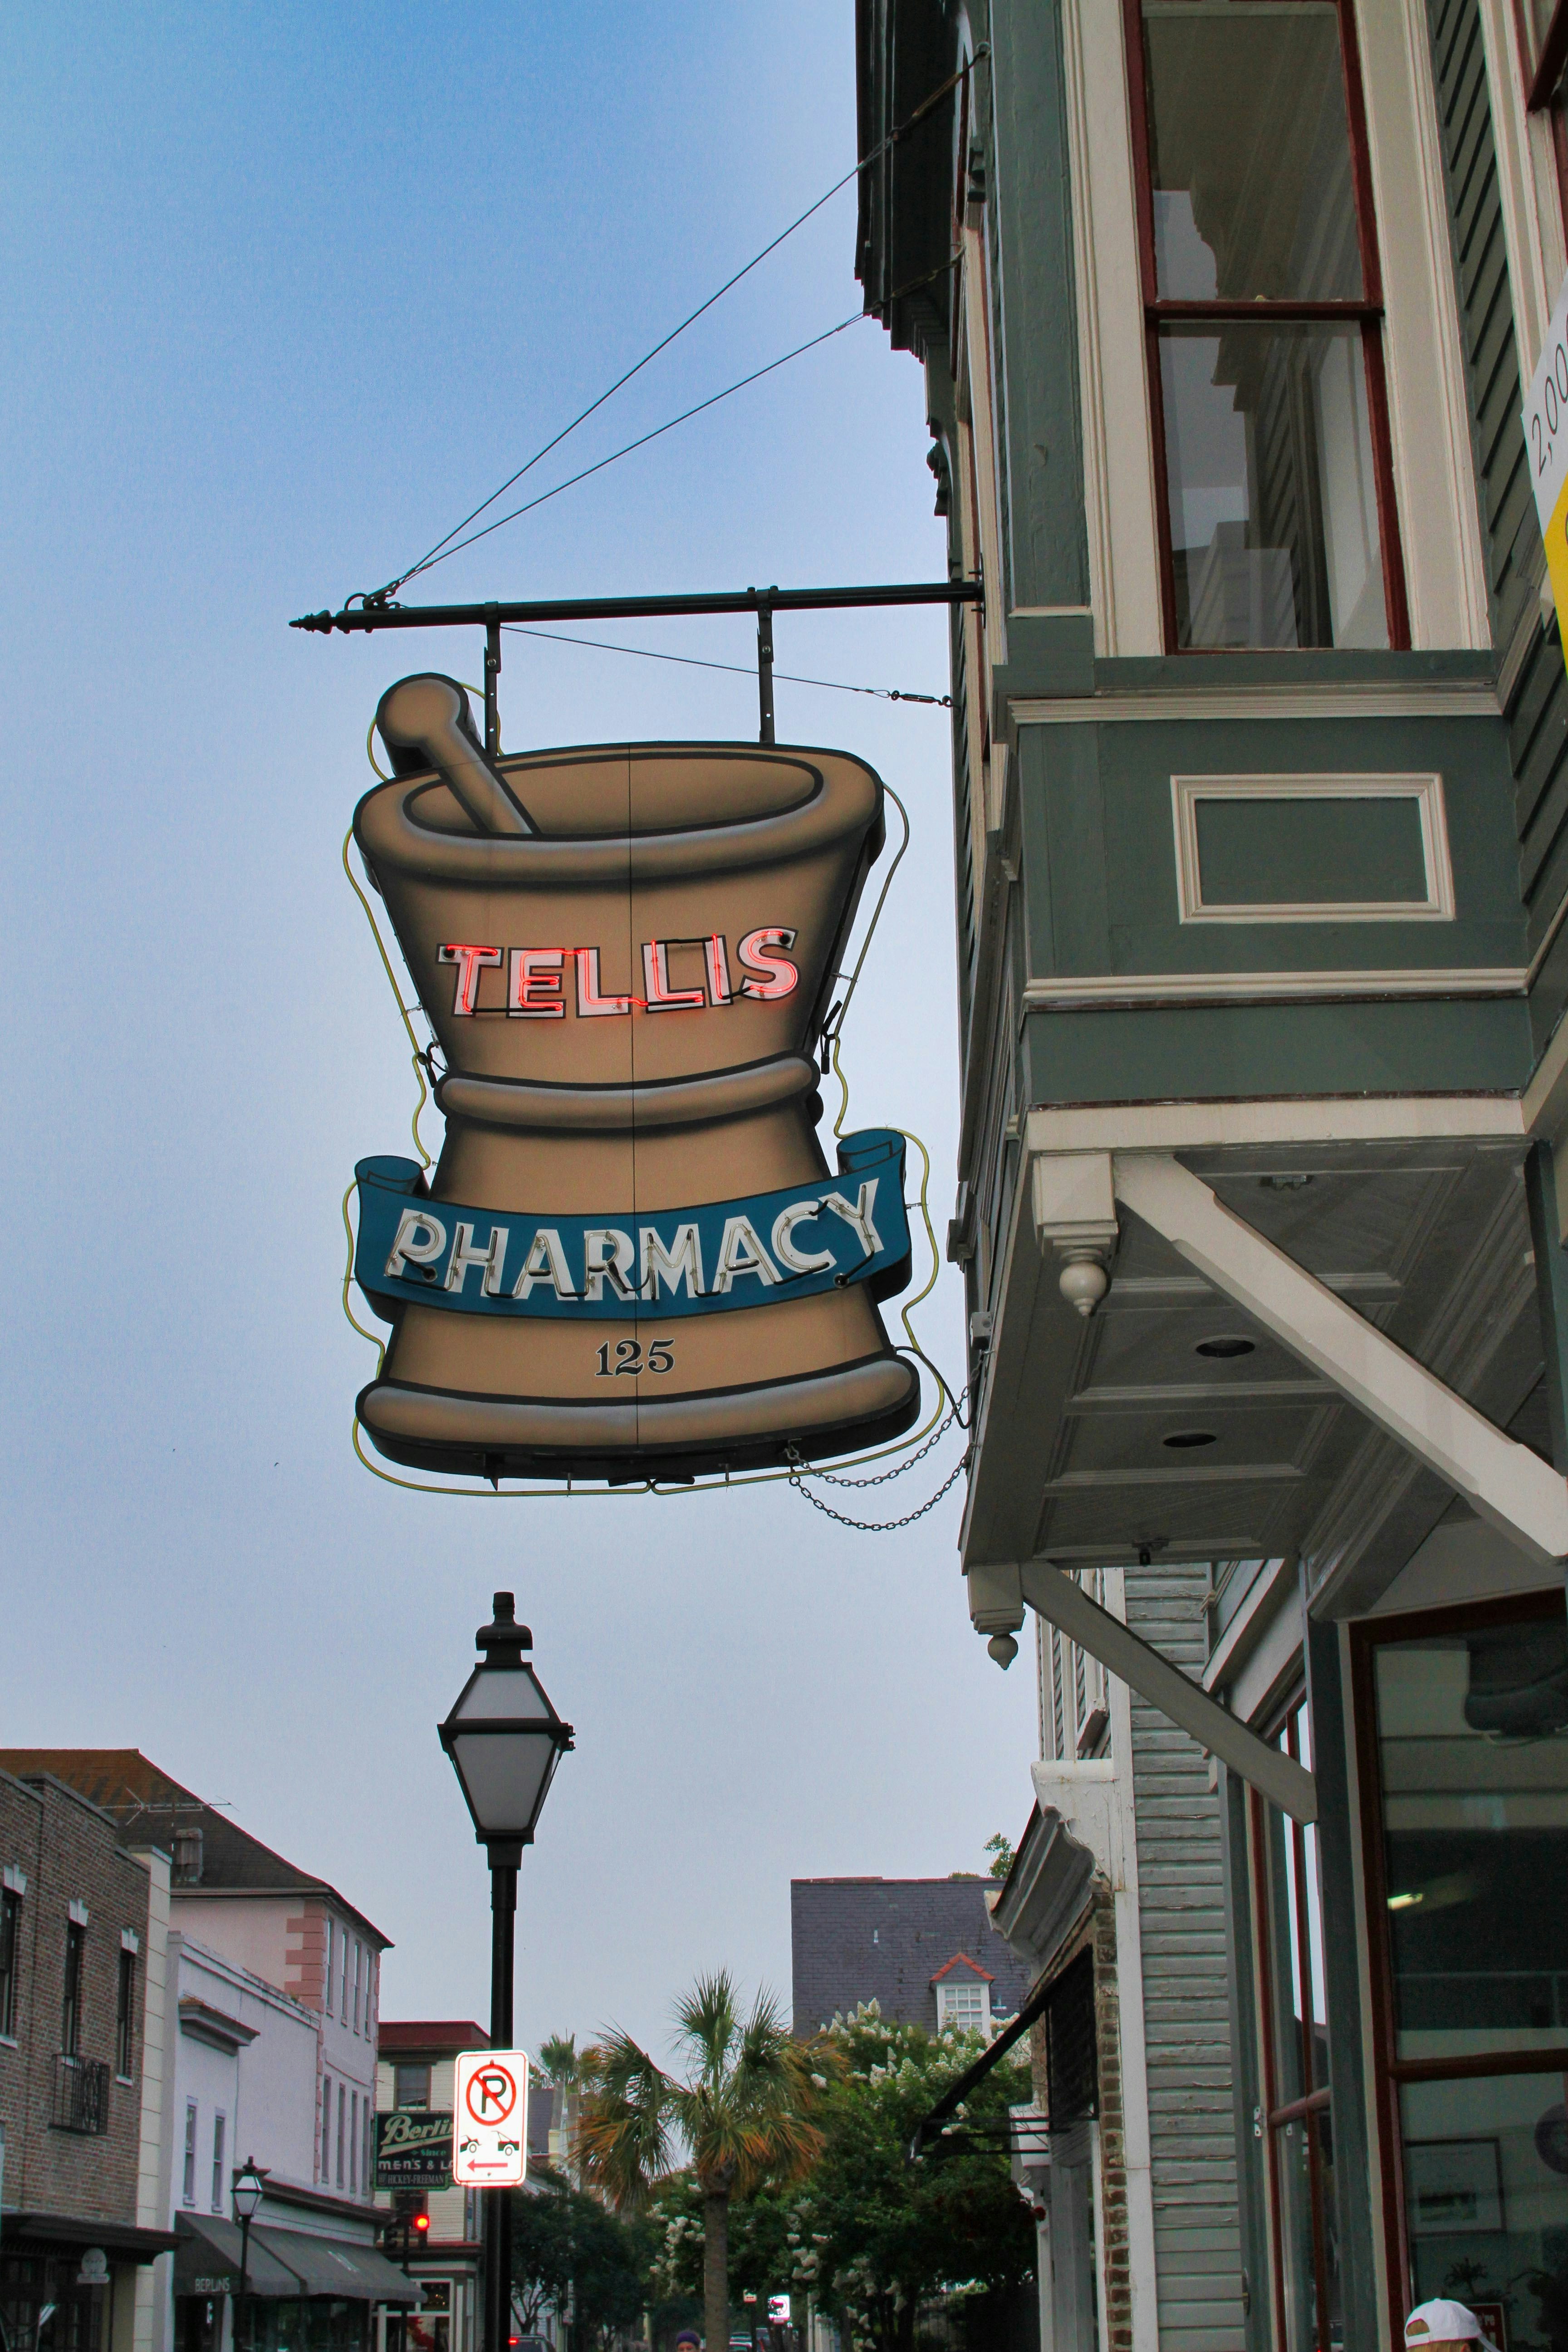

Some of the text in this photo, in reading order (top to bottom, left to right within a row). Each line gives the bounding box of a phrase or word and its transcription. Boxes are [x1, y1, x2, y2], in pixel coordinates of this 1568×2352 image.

[1532, 313, 1568, 478] 2,00
[436, 926, 801, 1018] TELLIS
[386, 1177, 885, 1301] PHARMACY
[595, 1338, 675, 1377] 125
[388, 2174, 444, 2184] HICKEY-FREEMAN
[427, 2160, 434, 2170] &
